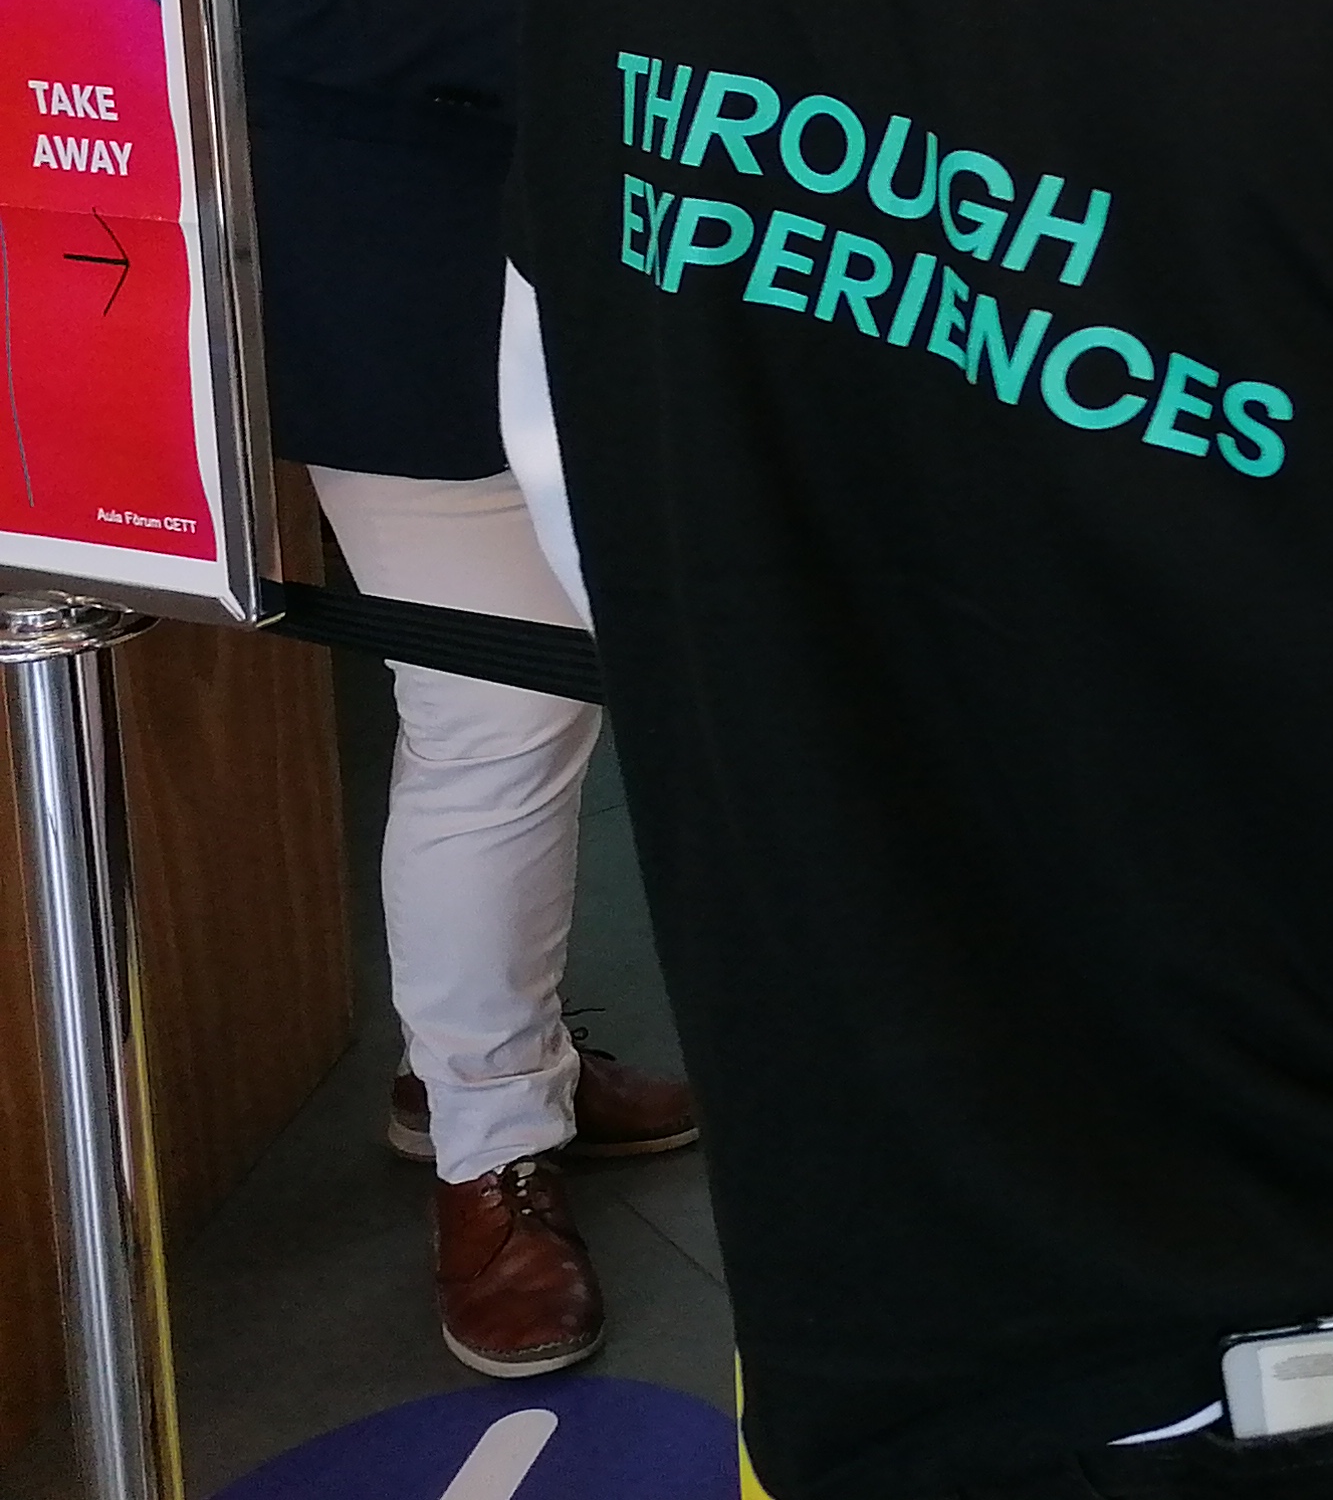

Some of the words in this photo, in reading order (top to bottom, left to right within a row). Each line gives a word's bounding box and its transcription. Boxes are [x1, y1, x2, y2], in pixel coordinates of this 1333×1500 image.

[28, 80, 118, 121] TAKE
[33, 134, 132, 176] AWAY
[617, 51, 1111, 286] THROUGH
[621, 174, 1293, 478] EXPERIENCES
[97, 507, 122, 524] Aula
[163, 516, 197, 534] CETT
